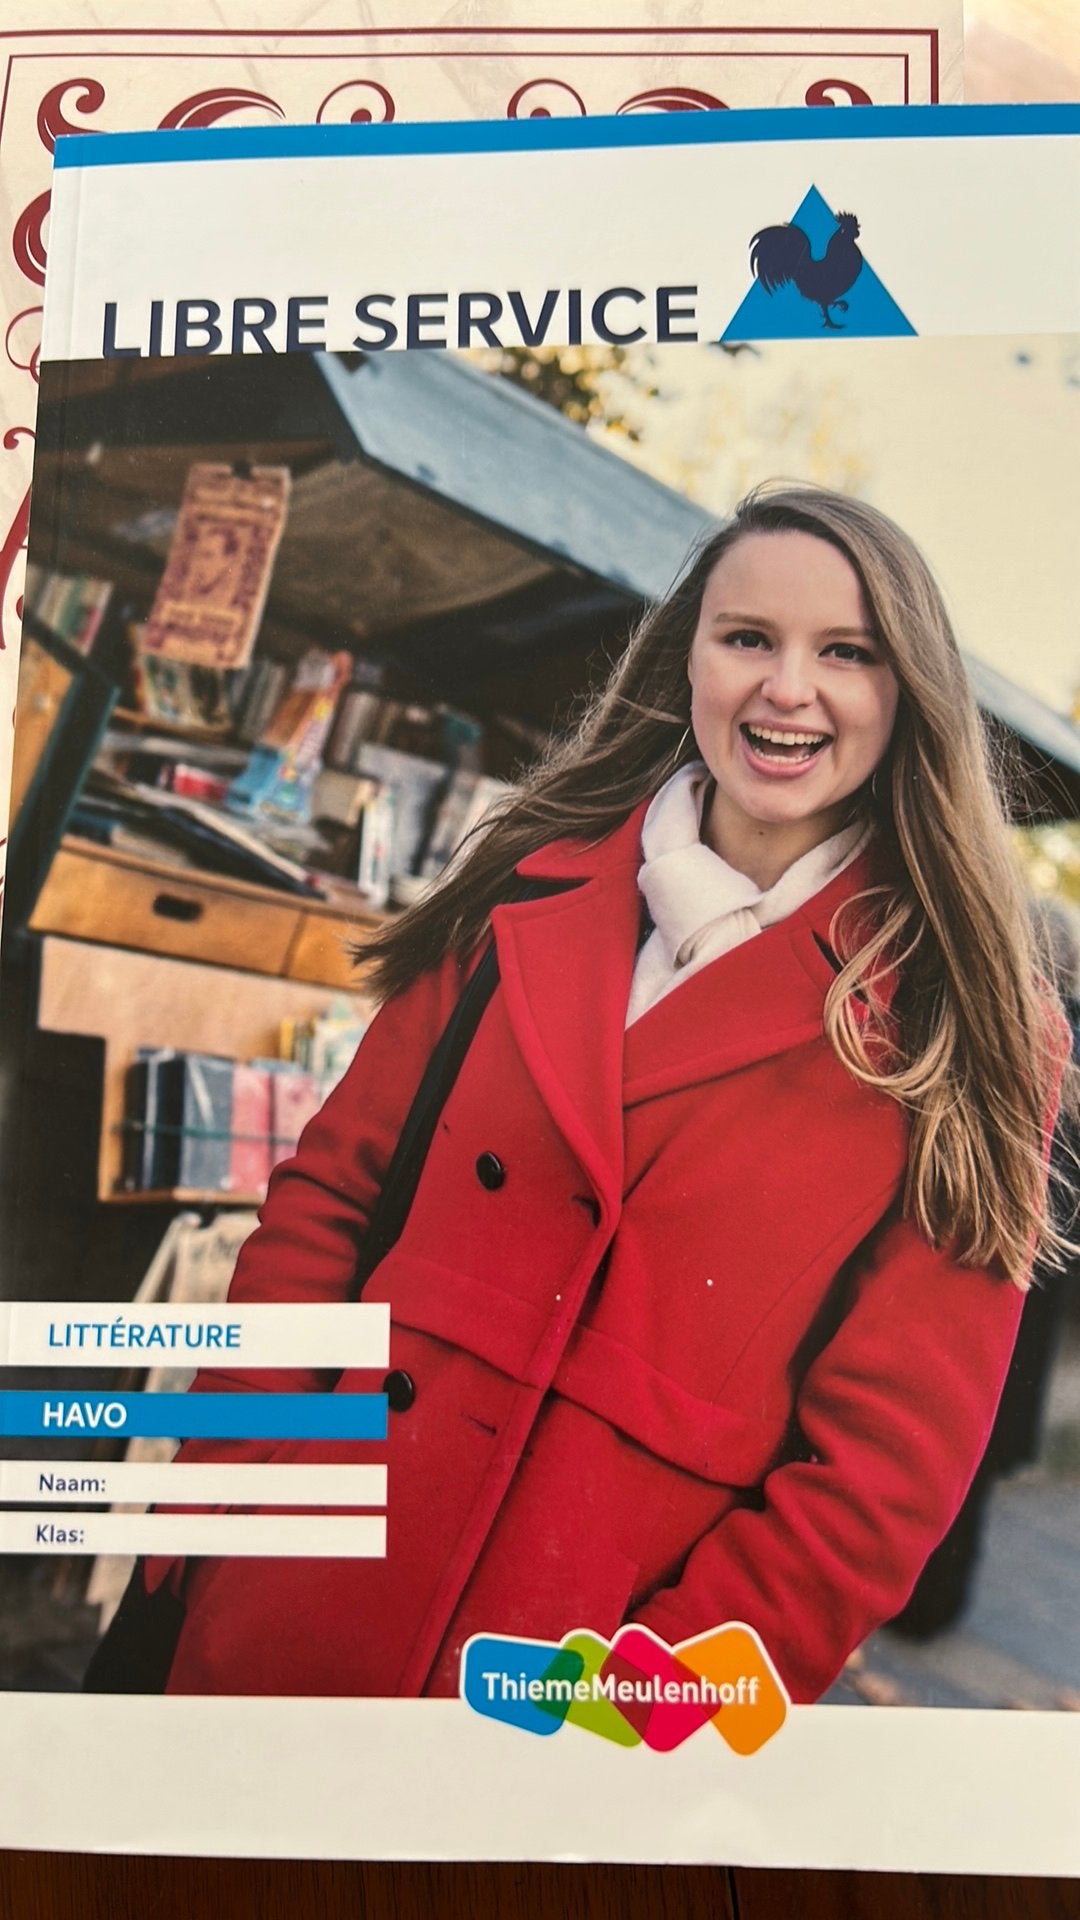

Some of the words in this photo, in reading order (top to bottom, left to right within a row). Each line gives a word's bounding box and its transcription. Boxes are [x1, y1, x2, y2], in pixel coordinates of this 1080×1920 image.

[102, 296, 329, 358] LIBRE
[352, 285, 698, 350] SERVICE
[48, 1317, 241, 1348] LITTÉRATURE
[42, 1402, 127, 1428] HAVO
[38, 1473, 106, 1492] Naam:
[36, 1524, 85, 1544] Klas:
[481, 1672, 760, 1704] ThiemeMeulenhoff
